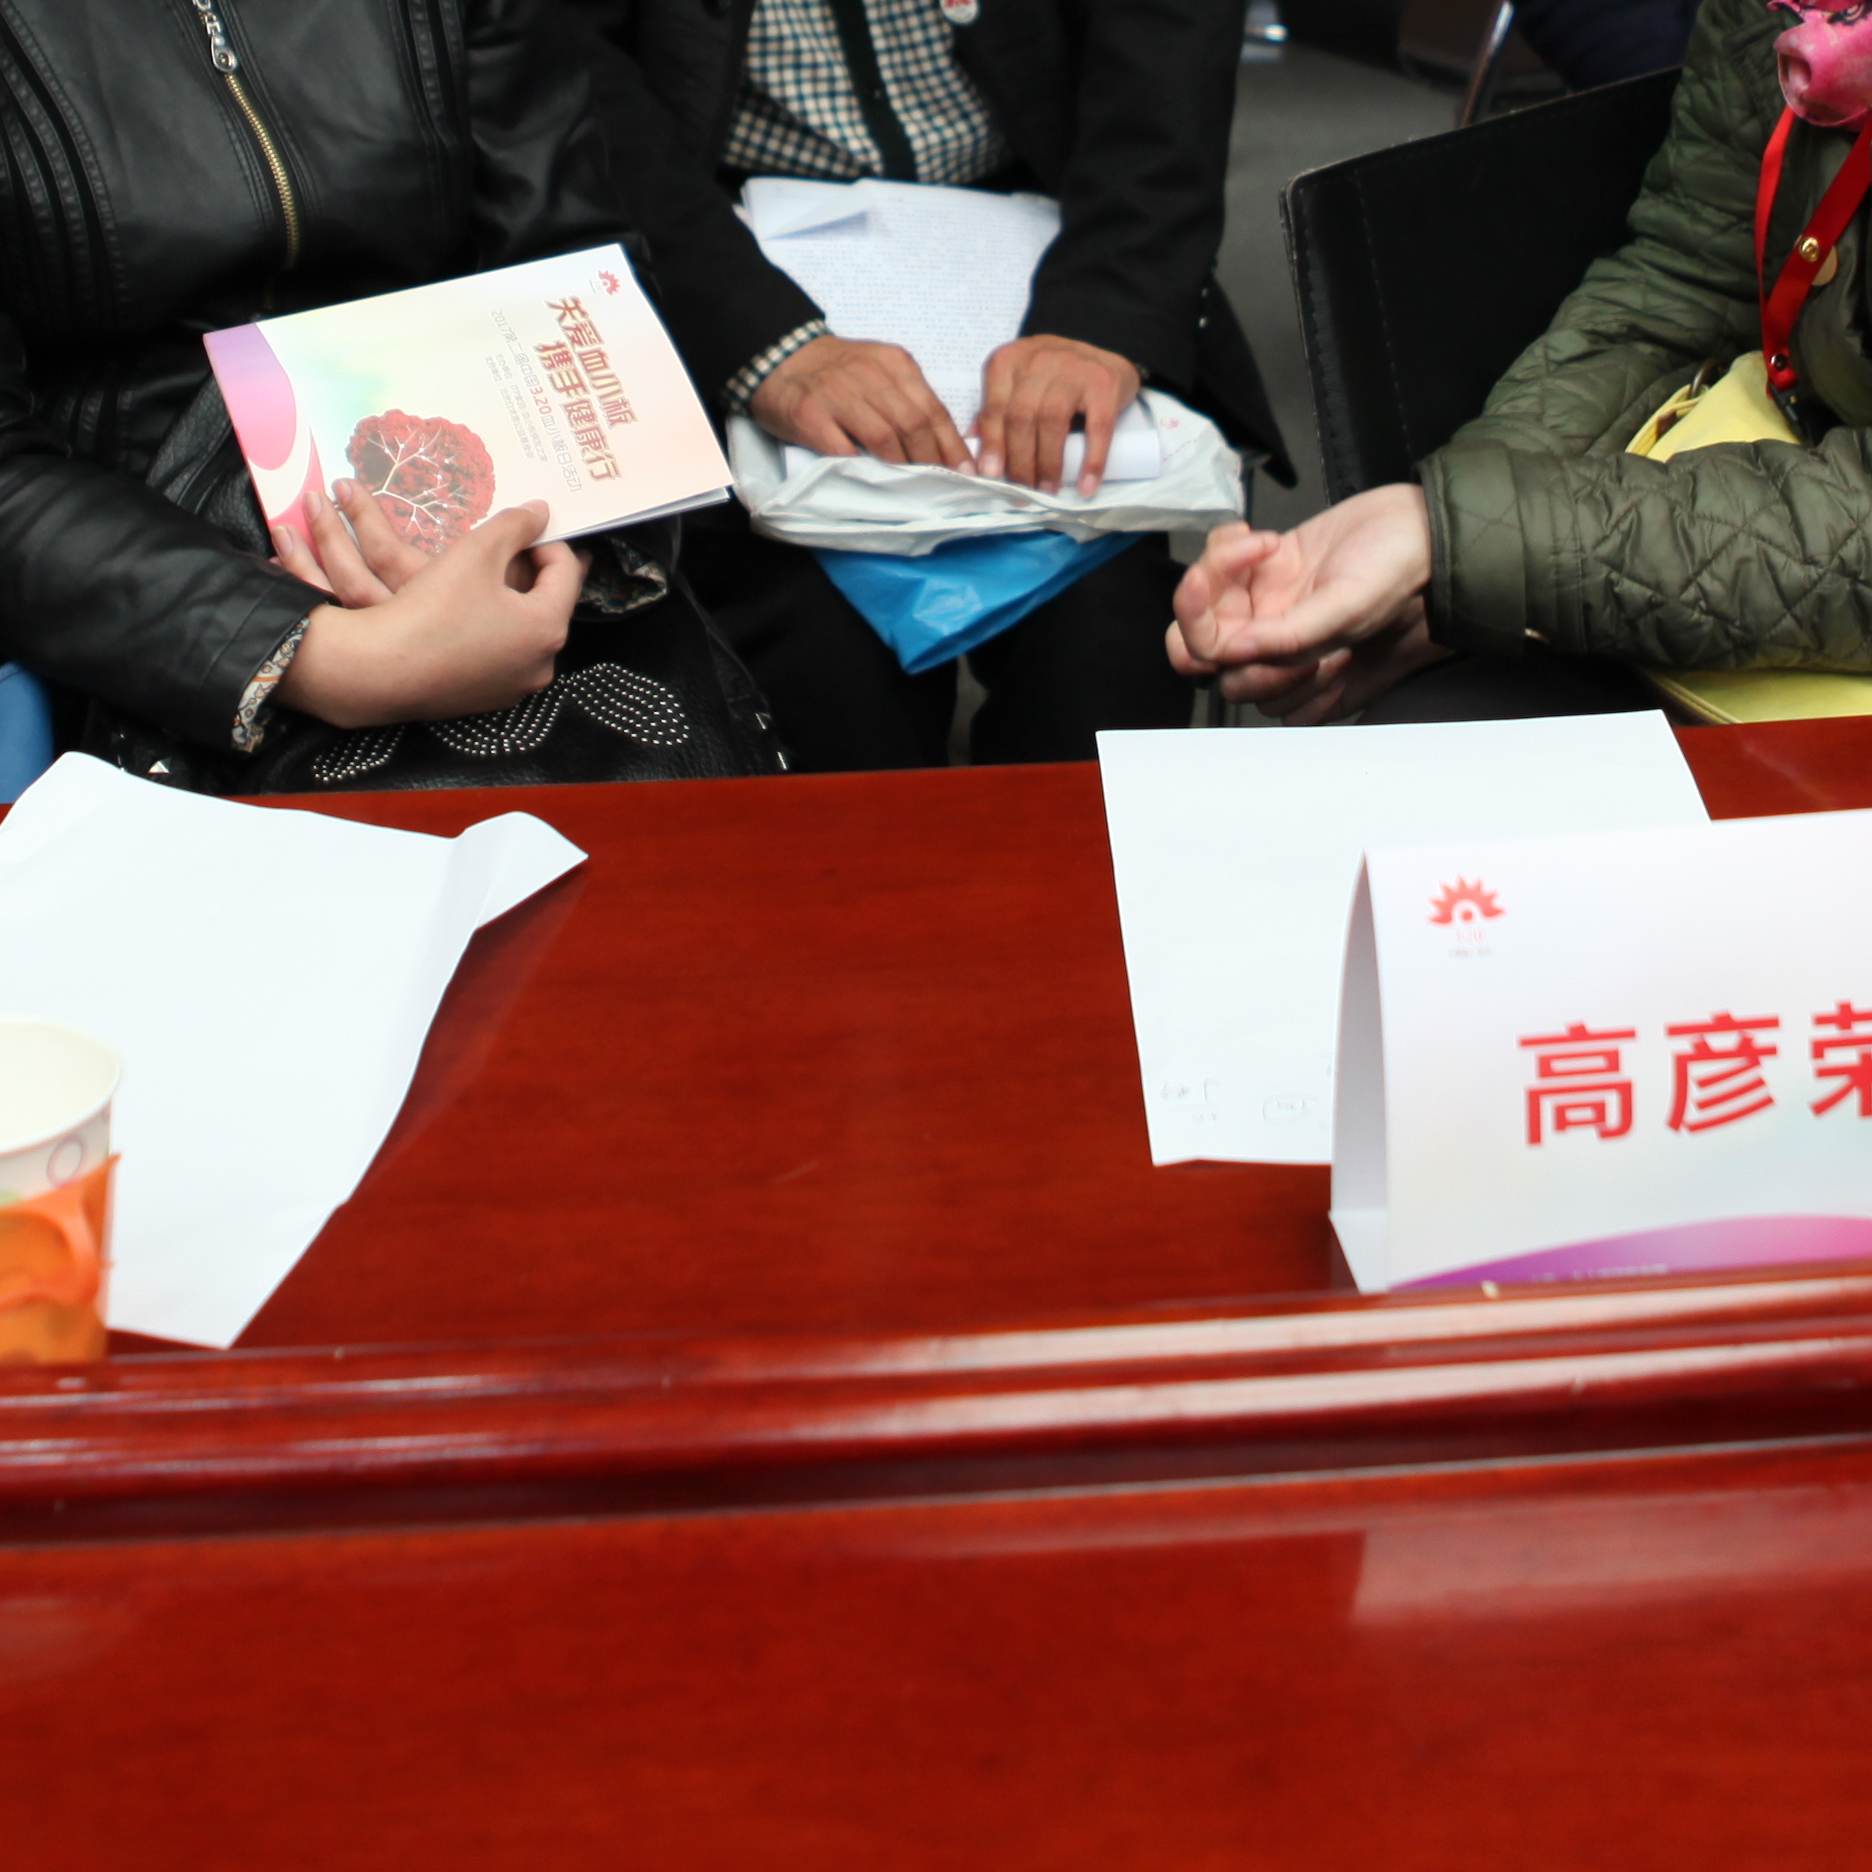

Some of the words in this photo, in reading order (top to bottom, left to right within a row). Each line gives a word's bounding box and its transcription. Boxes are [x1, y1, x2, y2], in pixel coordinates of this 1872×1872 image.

[535, 340, 621, 482] 携手健康行
[546, 295, 639, 430] 关爱血小板
